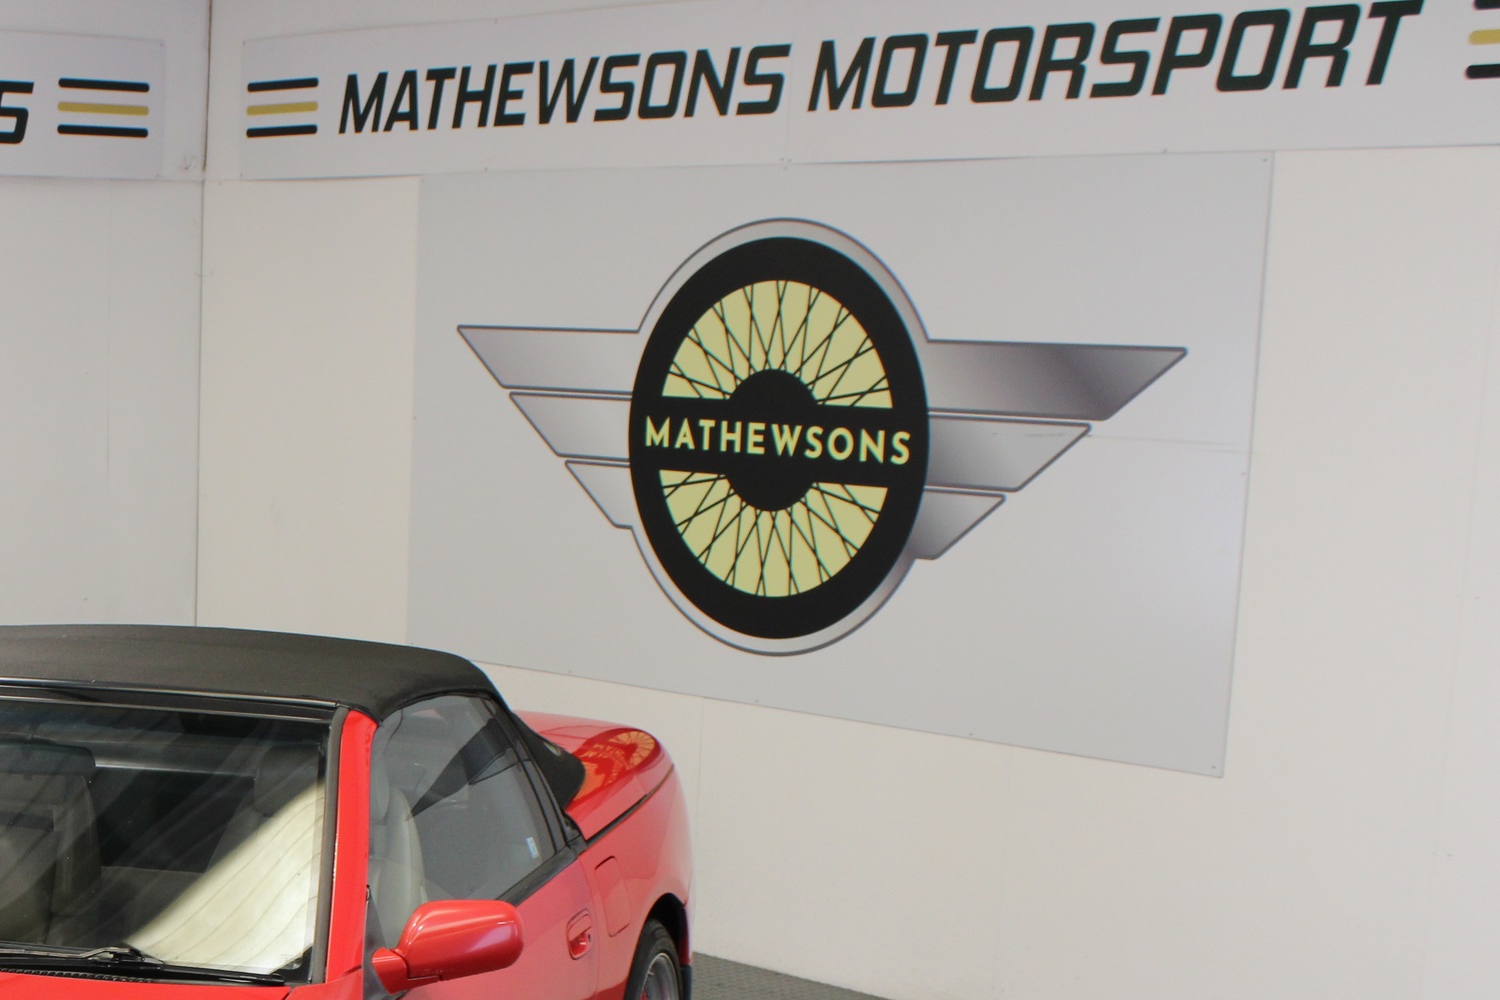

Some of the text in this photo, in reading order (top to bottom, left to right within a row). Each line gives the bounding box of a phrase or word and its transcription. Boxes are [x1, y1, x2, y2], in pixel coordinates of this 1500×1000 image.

[338, 0, 1424, 134] MATHEWSONS MOTORSPORT
[645, 416, 911, 465] MATHEWSONS
